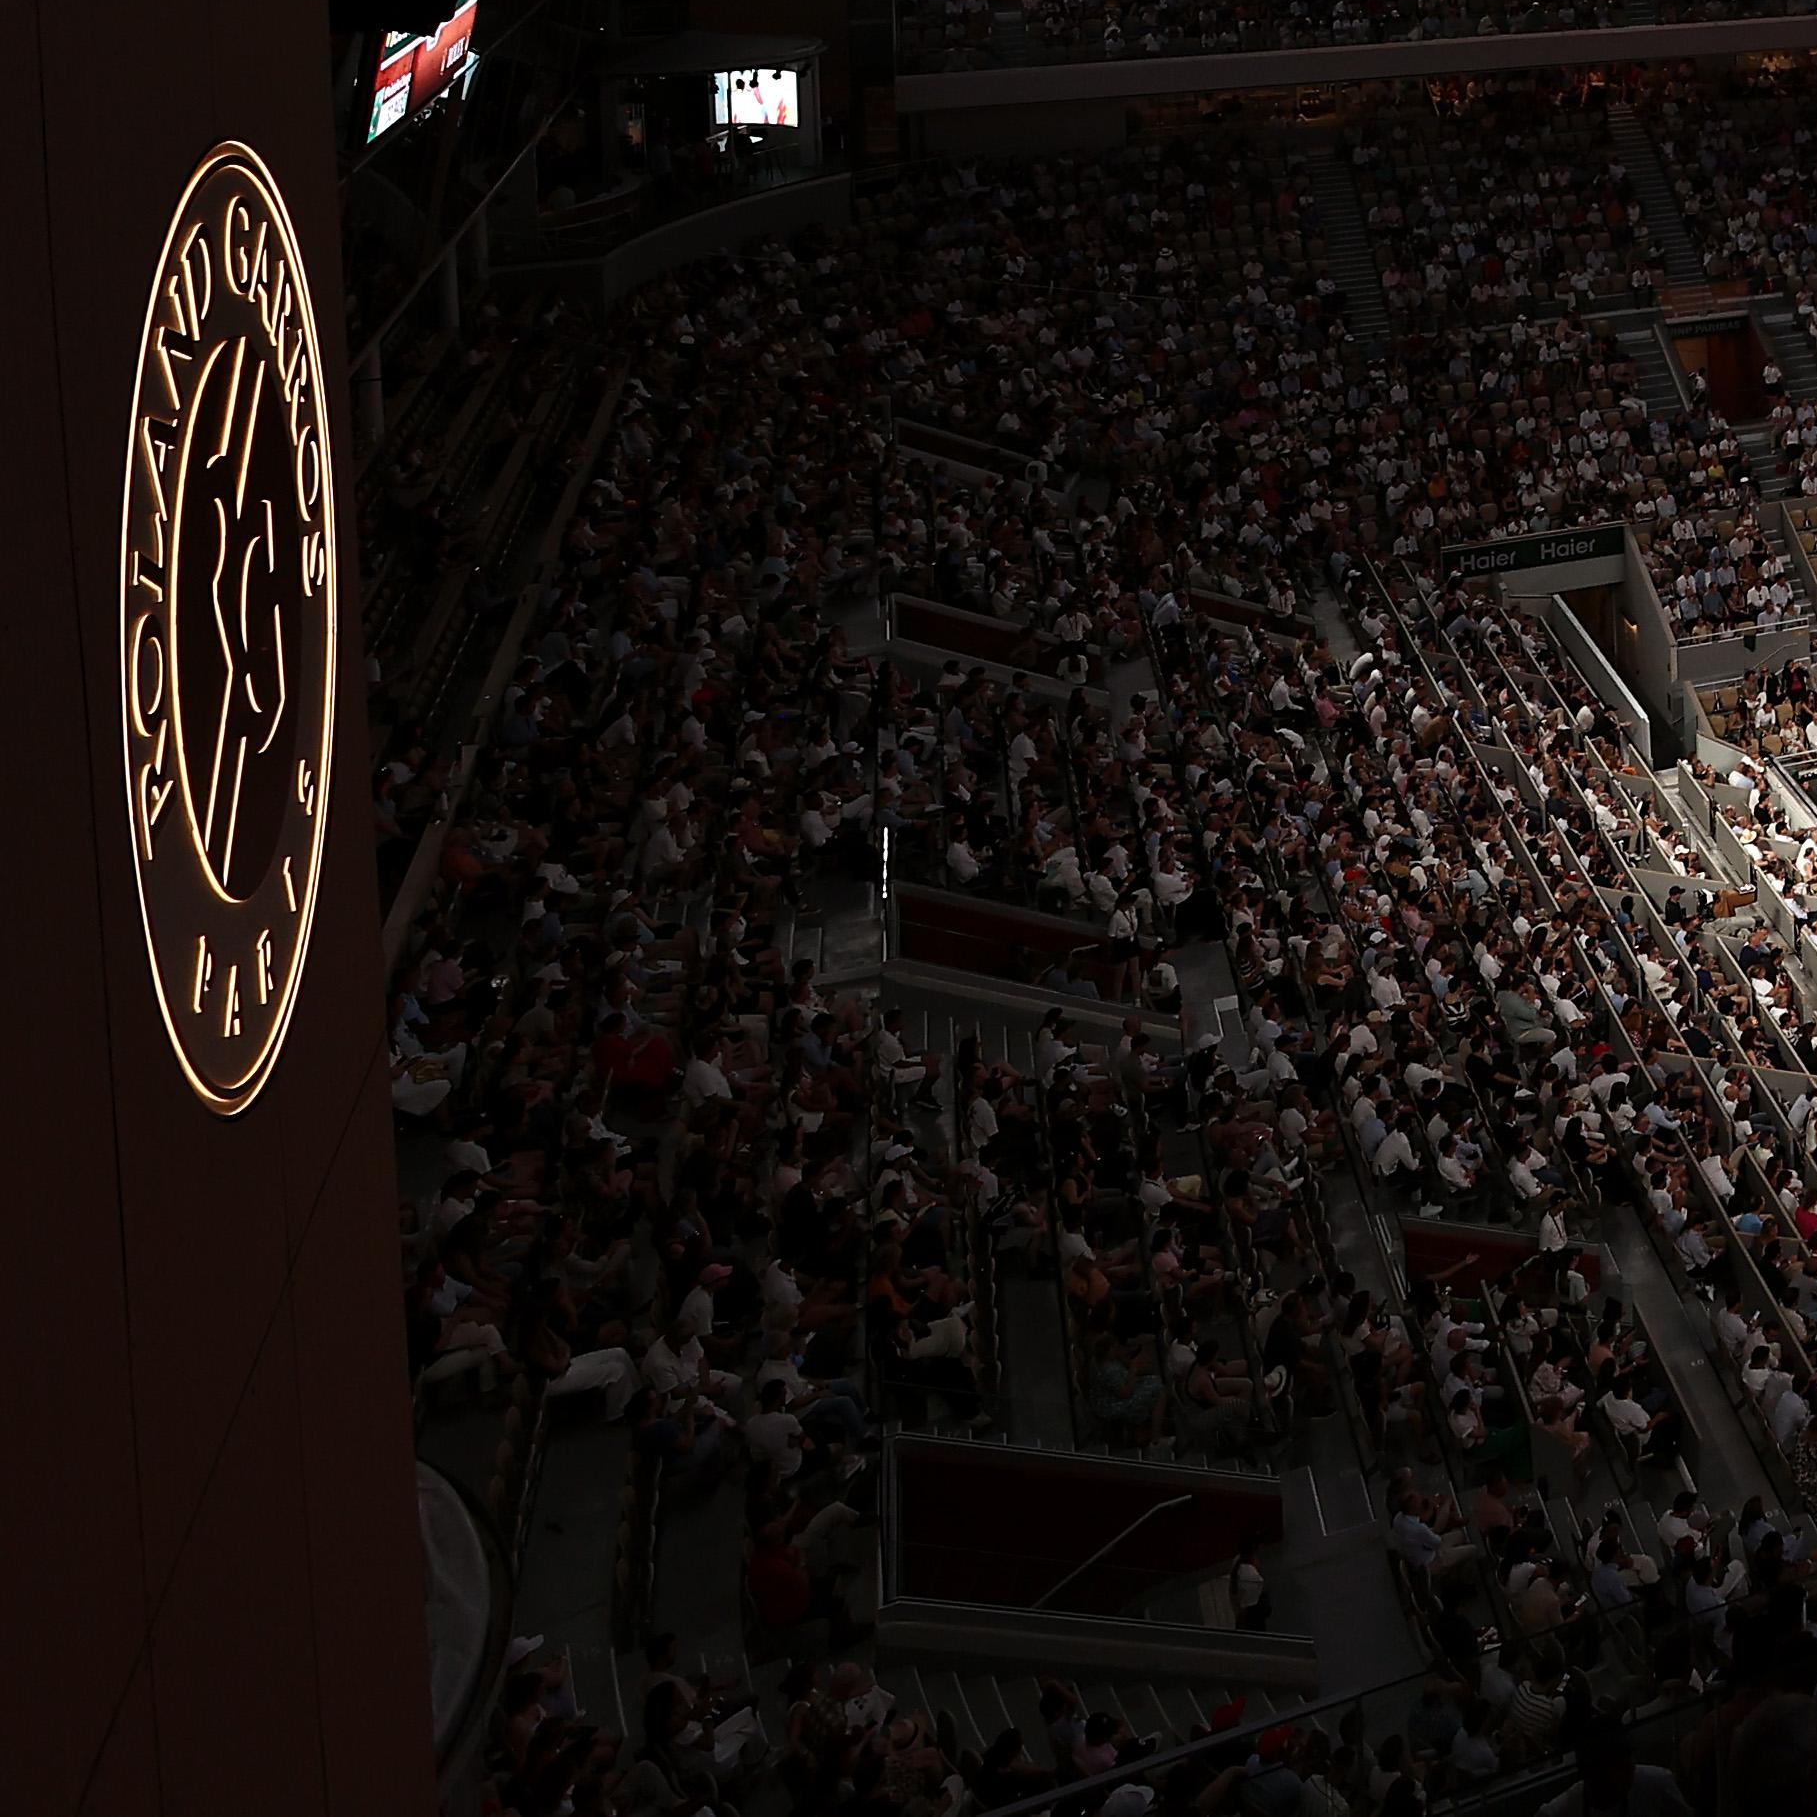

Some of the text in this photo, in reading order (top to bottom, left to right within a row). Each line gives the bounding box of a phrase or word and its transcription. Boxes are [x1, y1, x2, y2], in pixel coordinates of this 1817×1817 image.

[132, 195, 327, 862] ROLAND GARROS
[1459, 550, 1517, 572] Haier
[1540, 537, 1596, 561] Haier
[192, 758, 315, 1039] PARIS
